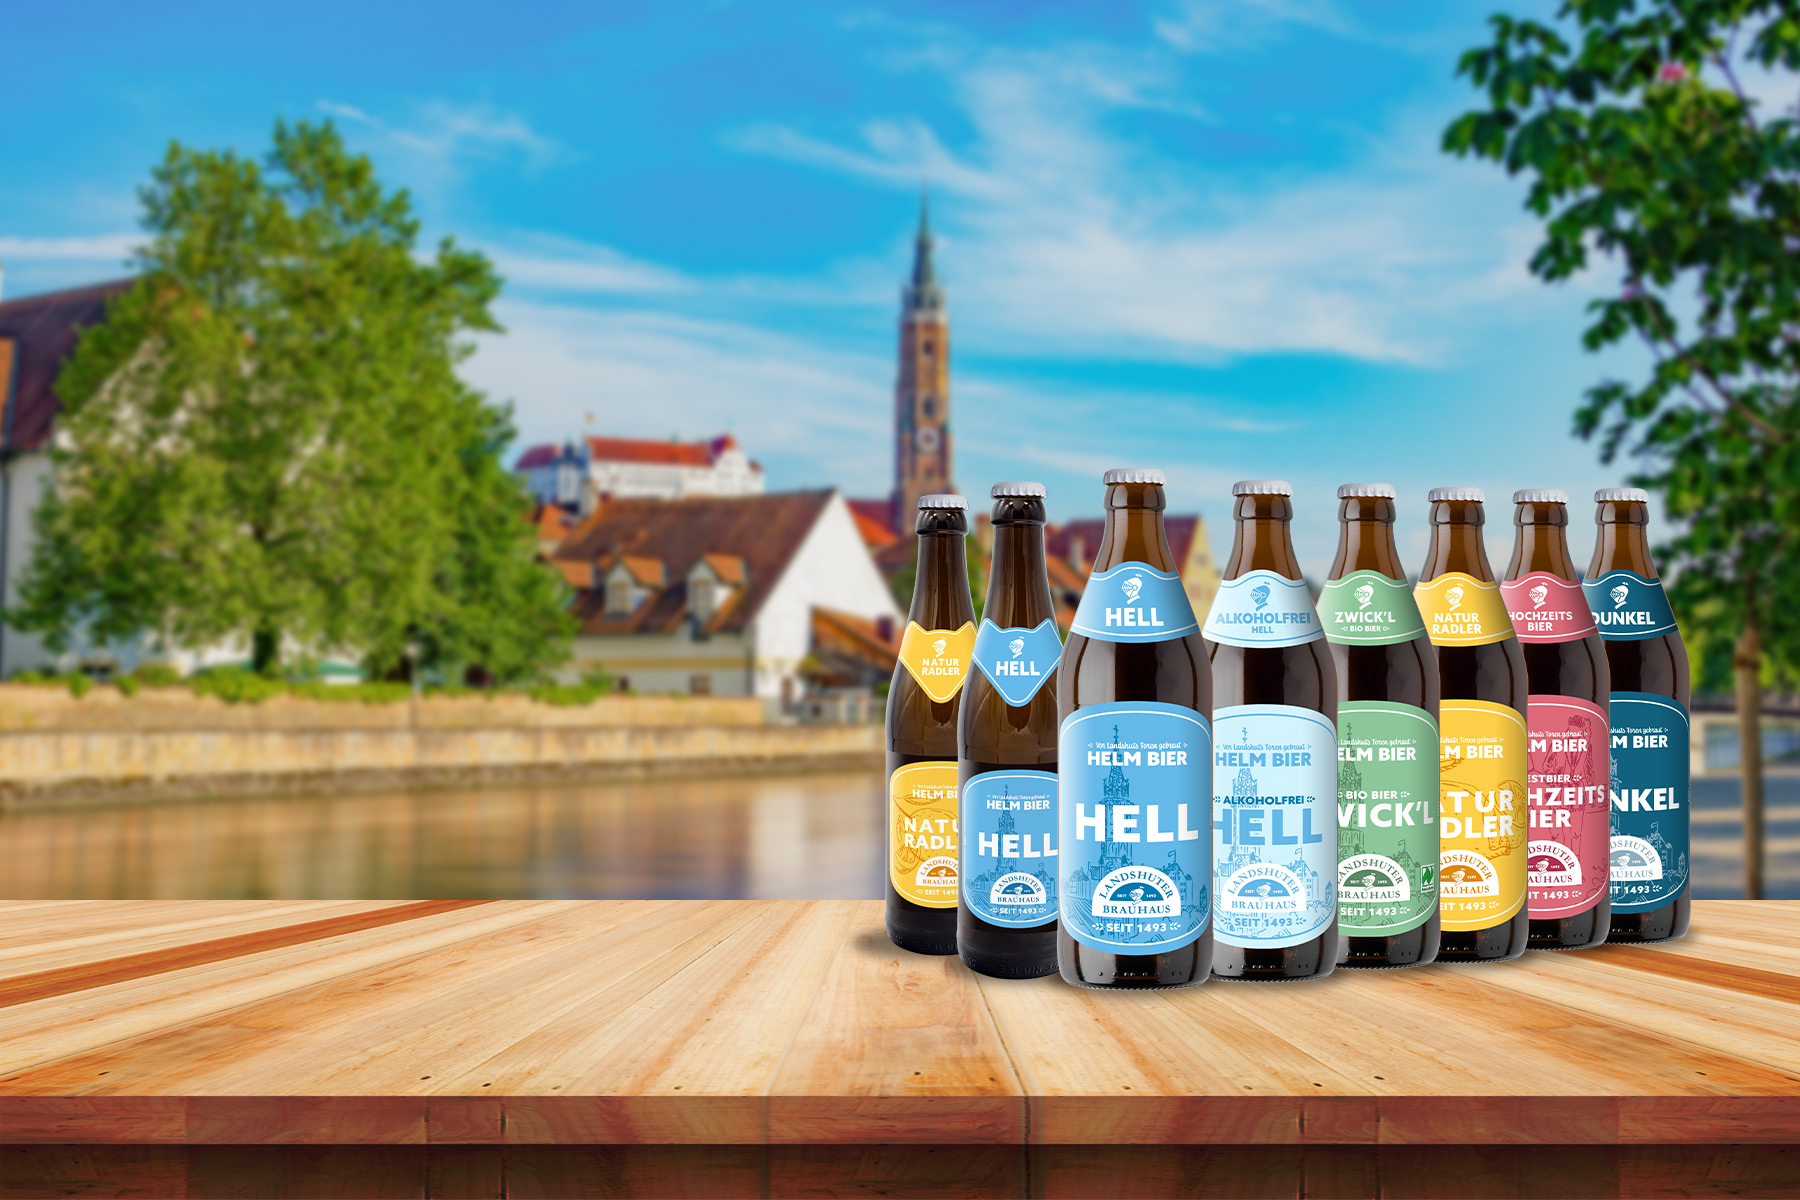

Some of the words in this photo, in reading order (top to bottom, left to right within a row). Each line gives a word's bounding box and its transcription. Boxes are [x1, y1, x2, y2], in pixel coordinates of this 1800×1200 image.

[1106, 607, 1164, 627] HELL
[1216, 612, 1311, 625] ALKOHOLFREI
[1335, 612, 1396, 623] ZWICK'L
[1434, 613, 1479, 623] NATUR
[1591, 611, 1655, 625] DUNKEL
[1252, 626, 1274, 634] HELL
[1432, 624, 1482, 634] RADLER
[1528, 622, 1553, 632] BIER
[922, 658, 959, 666] NATUR
[922, 667, 960, 676] RADLER
[996, 661, 1040, 676] HELL
[1552, 739, 1588, 753] BIER
[1633, 735, 1668, 748] BIER
[1379, 747, 1417, 761] BIER
[1467, 745, 1504, 759] BIER
[1088, 751, 1141, 767] HELM
[1148, 751, 1188, 767] BIER
[1216, 752, 1266, 767] HELM
[1272, 752, 1312, 767] BIER
[912, 789, 944, 799] HELM
[946, 790, 958, 799] BI
[1346, 791, 1368, 800] BIO
[1372, 791, 1398, 800] BIER
[986, 800, 1021, 811] HELM
[1024, 800, 1050, 811] BIER
[1223, 796, 1305, 805] ALKOHOLFREI
[1076, 803, 1199, 843] HELL
[1530, 810, 1572, 828] IER
[1213, 808, 1323, 846] HELL
[905, 833, 957, 850] RADL
[978, 831, 1058, 859] HELL
[1338, 858, 1404, 885] LANDSHUTER
[995, 875, 1042, 894] LANDSHUTER
[1099, 871, 1174, 899] LANDSHUTER
[1228, 868, 1300, 895] LANDSHUTER
[1338, 891, 1401, 899] BRAUHAUS
[1543, 891, 1569, 900] 1493
[1624, 886, 1650, 894] 1493
[1103, 905, 1171, 915] BRAUHAUS
[1232, 901, 1297, 910] BRAUHAUS
[1459, 902, 1486, 911] 1493
[1341, 908, 1366, 916] SEIT
[1370, 907, 1397, 916] 1493
[1235, 918, 1261, 927] SEIT
[1264, 918, 1293, 927] 1493
[1107, 924, 1133, 933] SEIT
[1137, 924, 1167, 933] 1493
